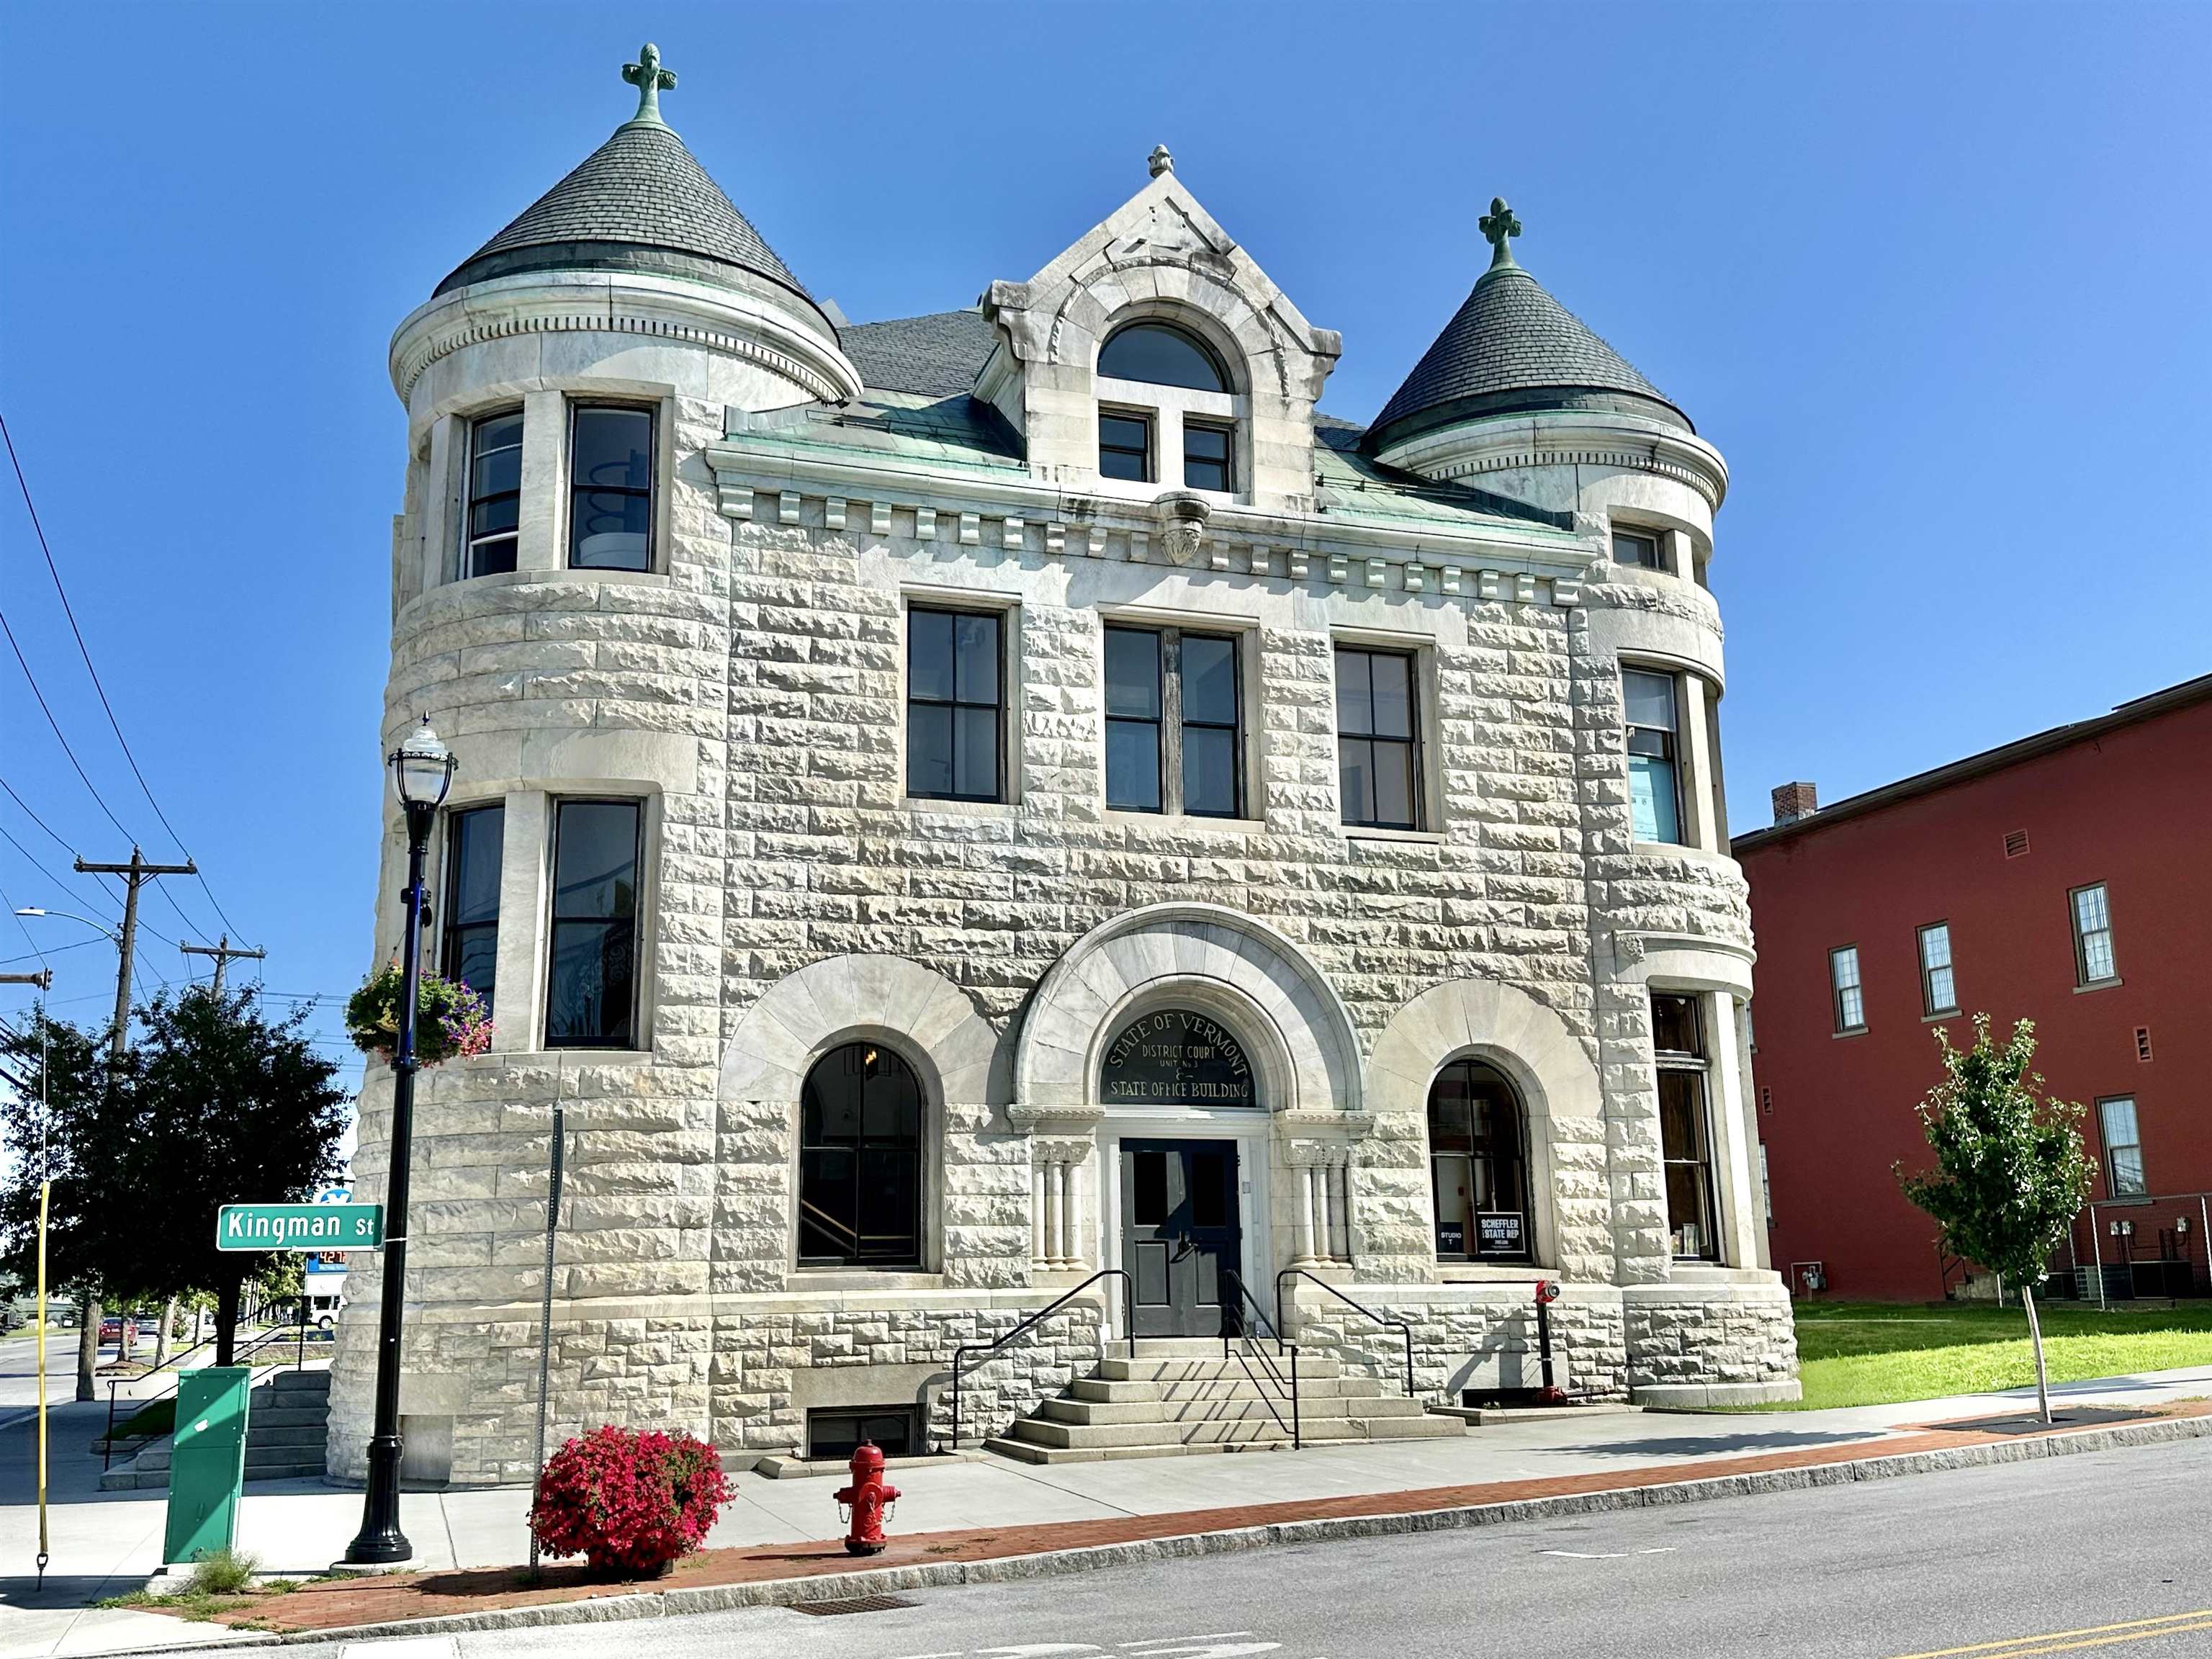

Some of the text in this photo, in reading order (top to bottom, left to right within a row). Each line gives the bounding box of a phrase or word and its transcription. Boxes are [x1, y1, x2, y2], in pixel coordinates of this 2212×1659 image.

[1110, 1013, 1248, 1076] STATE OF VERMONT
[1142, 1044, 1215, 1059] DISTRICT COURT
[1111, 1082, 1248, 1098] STATE OFFICE BUILDING
[228, 1212, 374, 1245] Kingman St
[1481, 1219, 1519, 1228] SCHEFFLER
[1485, 1229, 1506, 1238] STATE
[1506, 1229, 1519, 1238] REP
